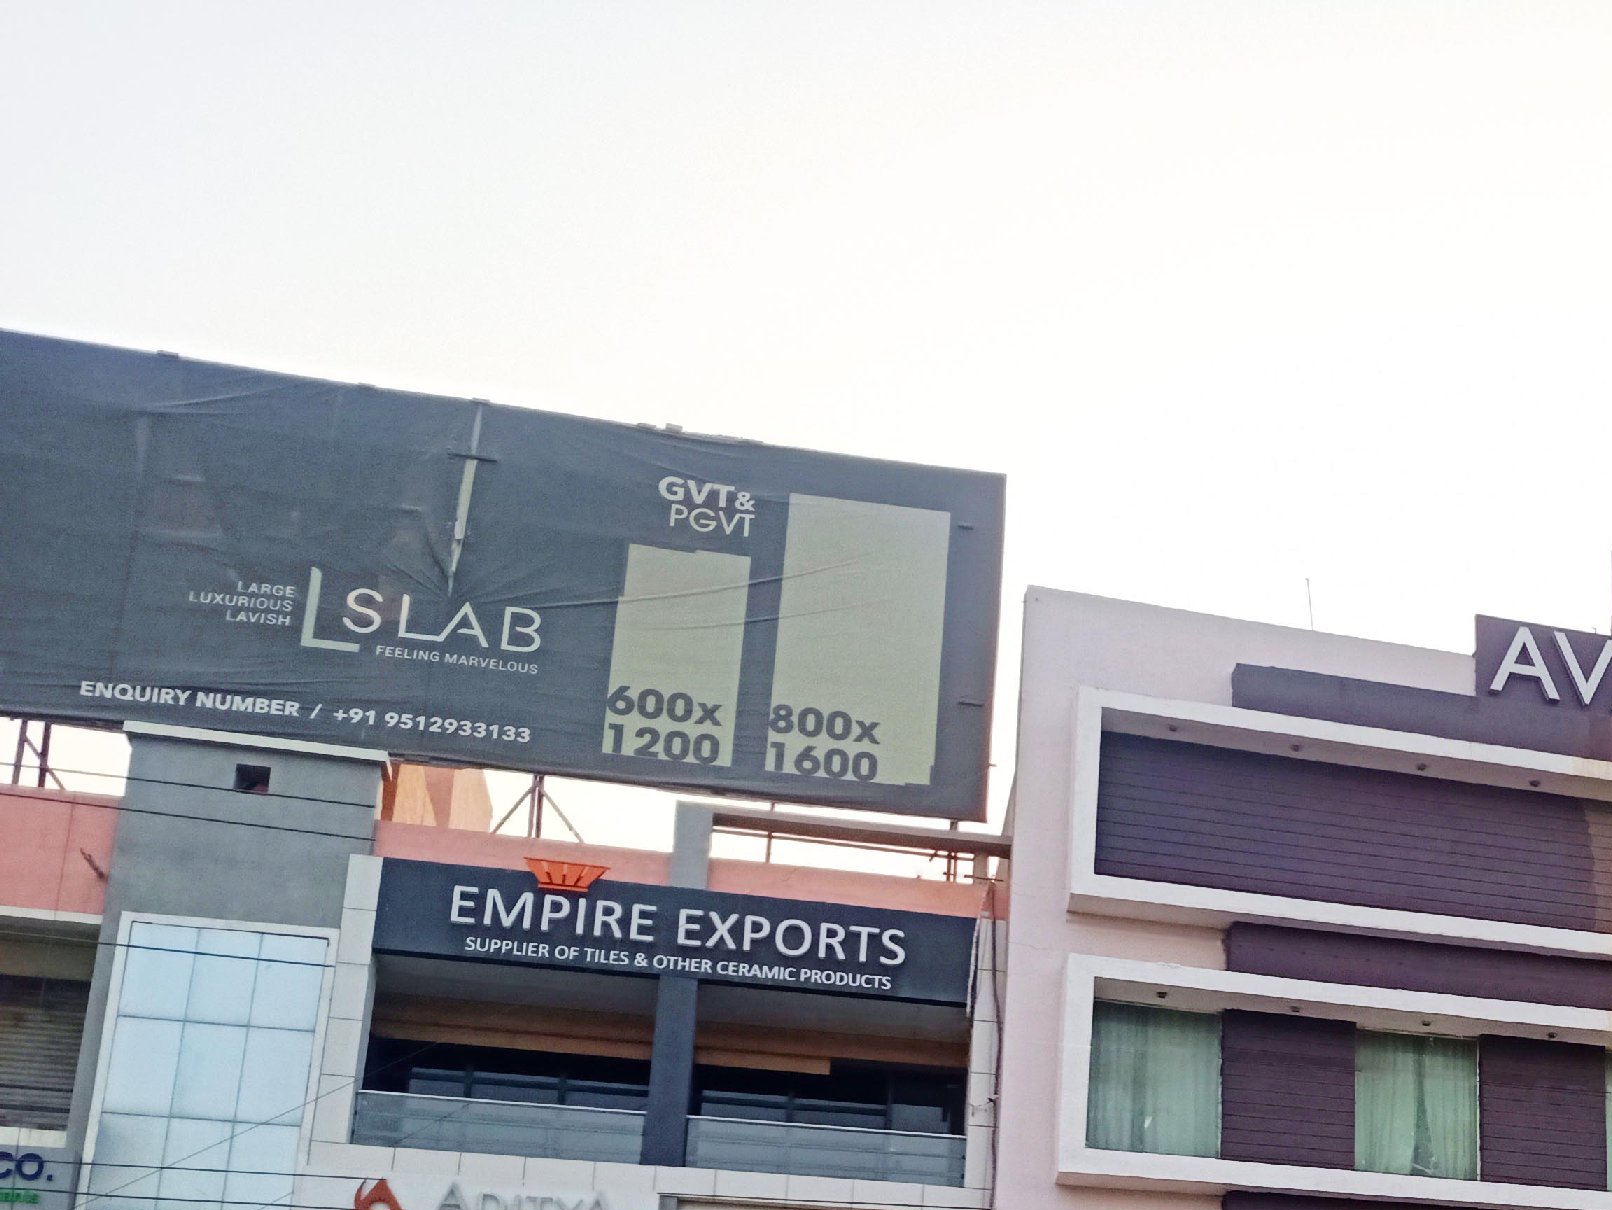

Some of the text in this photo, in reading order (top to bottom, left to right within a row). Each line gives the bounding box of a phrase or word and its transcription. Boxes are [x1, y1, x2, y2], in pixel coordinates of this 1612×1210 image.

[658, 475, 755, 511] GVT&
[669, 504, 755, 537] PGVT
[188, 591, 293, 611] LUXURIOUS
[237, 581, 296, 598] LARGE
[226, 609, 291, 626] LAVISH
[376, 645, 538, 675] FEELING MARVELOUS
[79, 681, 191, 706] ENQUIRY
[195, 691, 299, 717] NUMBER
[333, 708, 376, 725] +91
[385, 711, 530, 743] 9512933133
[607, 686, 722, 727] 600x
[769, 704, 880, 745] 800x
[608, 723, 720, 764] 1200
[769, 742, 878, 781] 1600
[450, 884, 907, 966] EMPIRE EXPORTS
[465, 936, 892, 990] SUPPLIER OF TILES & OTHER CERAMIC PRODUCTS
